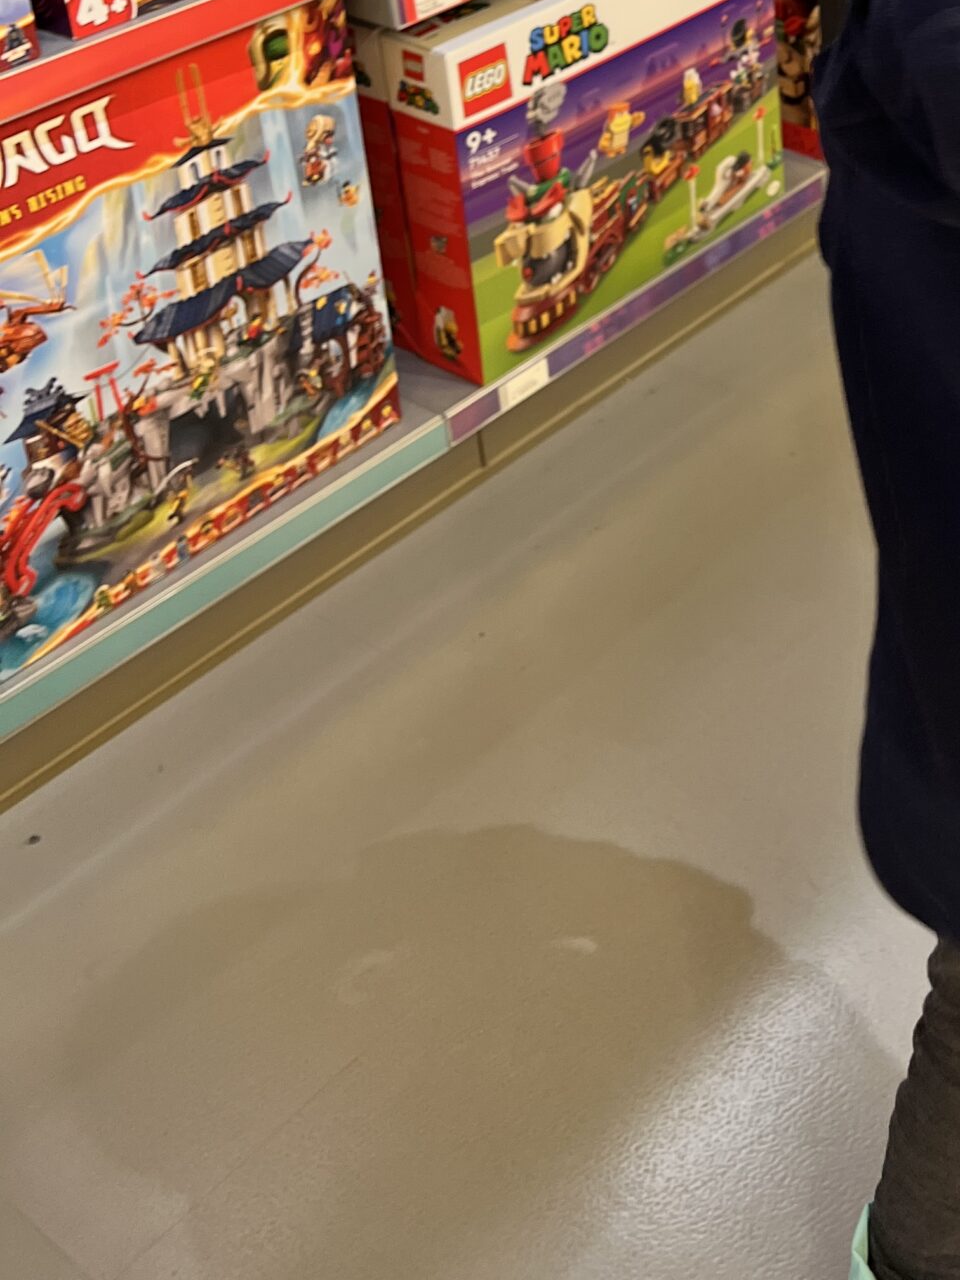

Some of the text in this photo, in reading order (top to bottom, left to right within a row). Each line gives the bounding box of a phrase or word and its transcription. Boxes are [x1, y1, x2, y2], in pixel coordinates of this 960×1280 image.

[529, 4, 597, 53] SUPER
[522, 22, 609, 86] MARIO
[464, 62, 508, 100] LEGO
[0, 94, 136, 189] AGO
[465, 127, 498, 154] 9+
